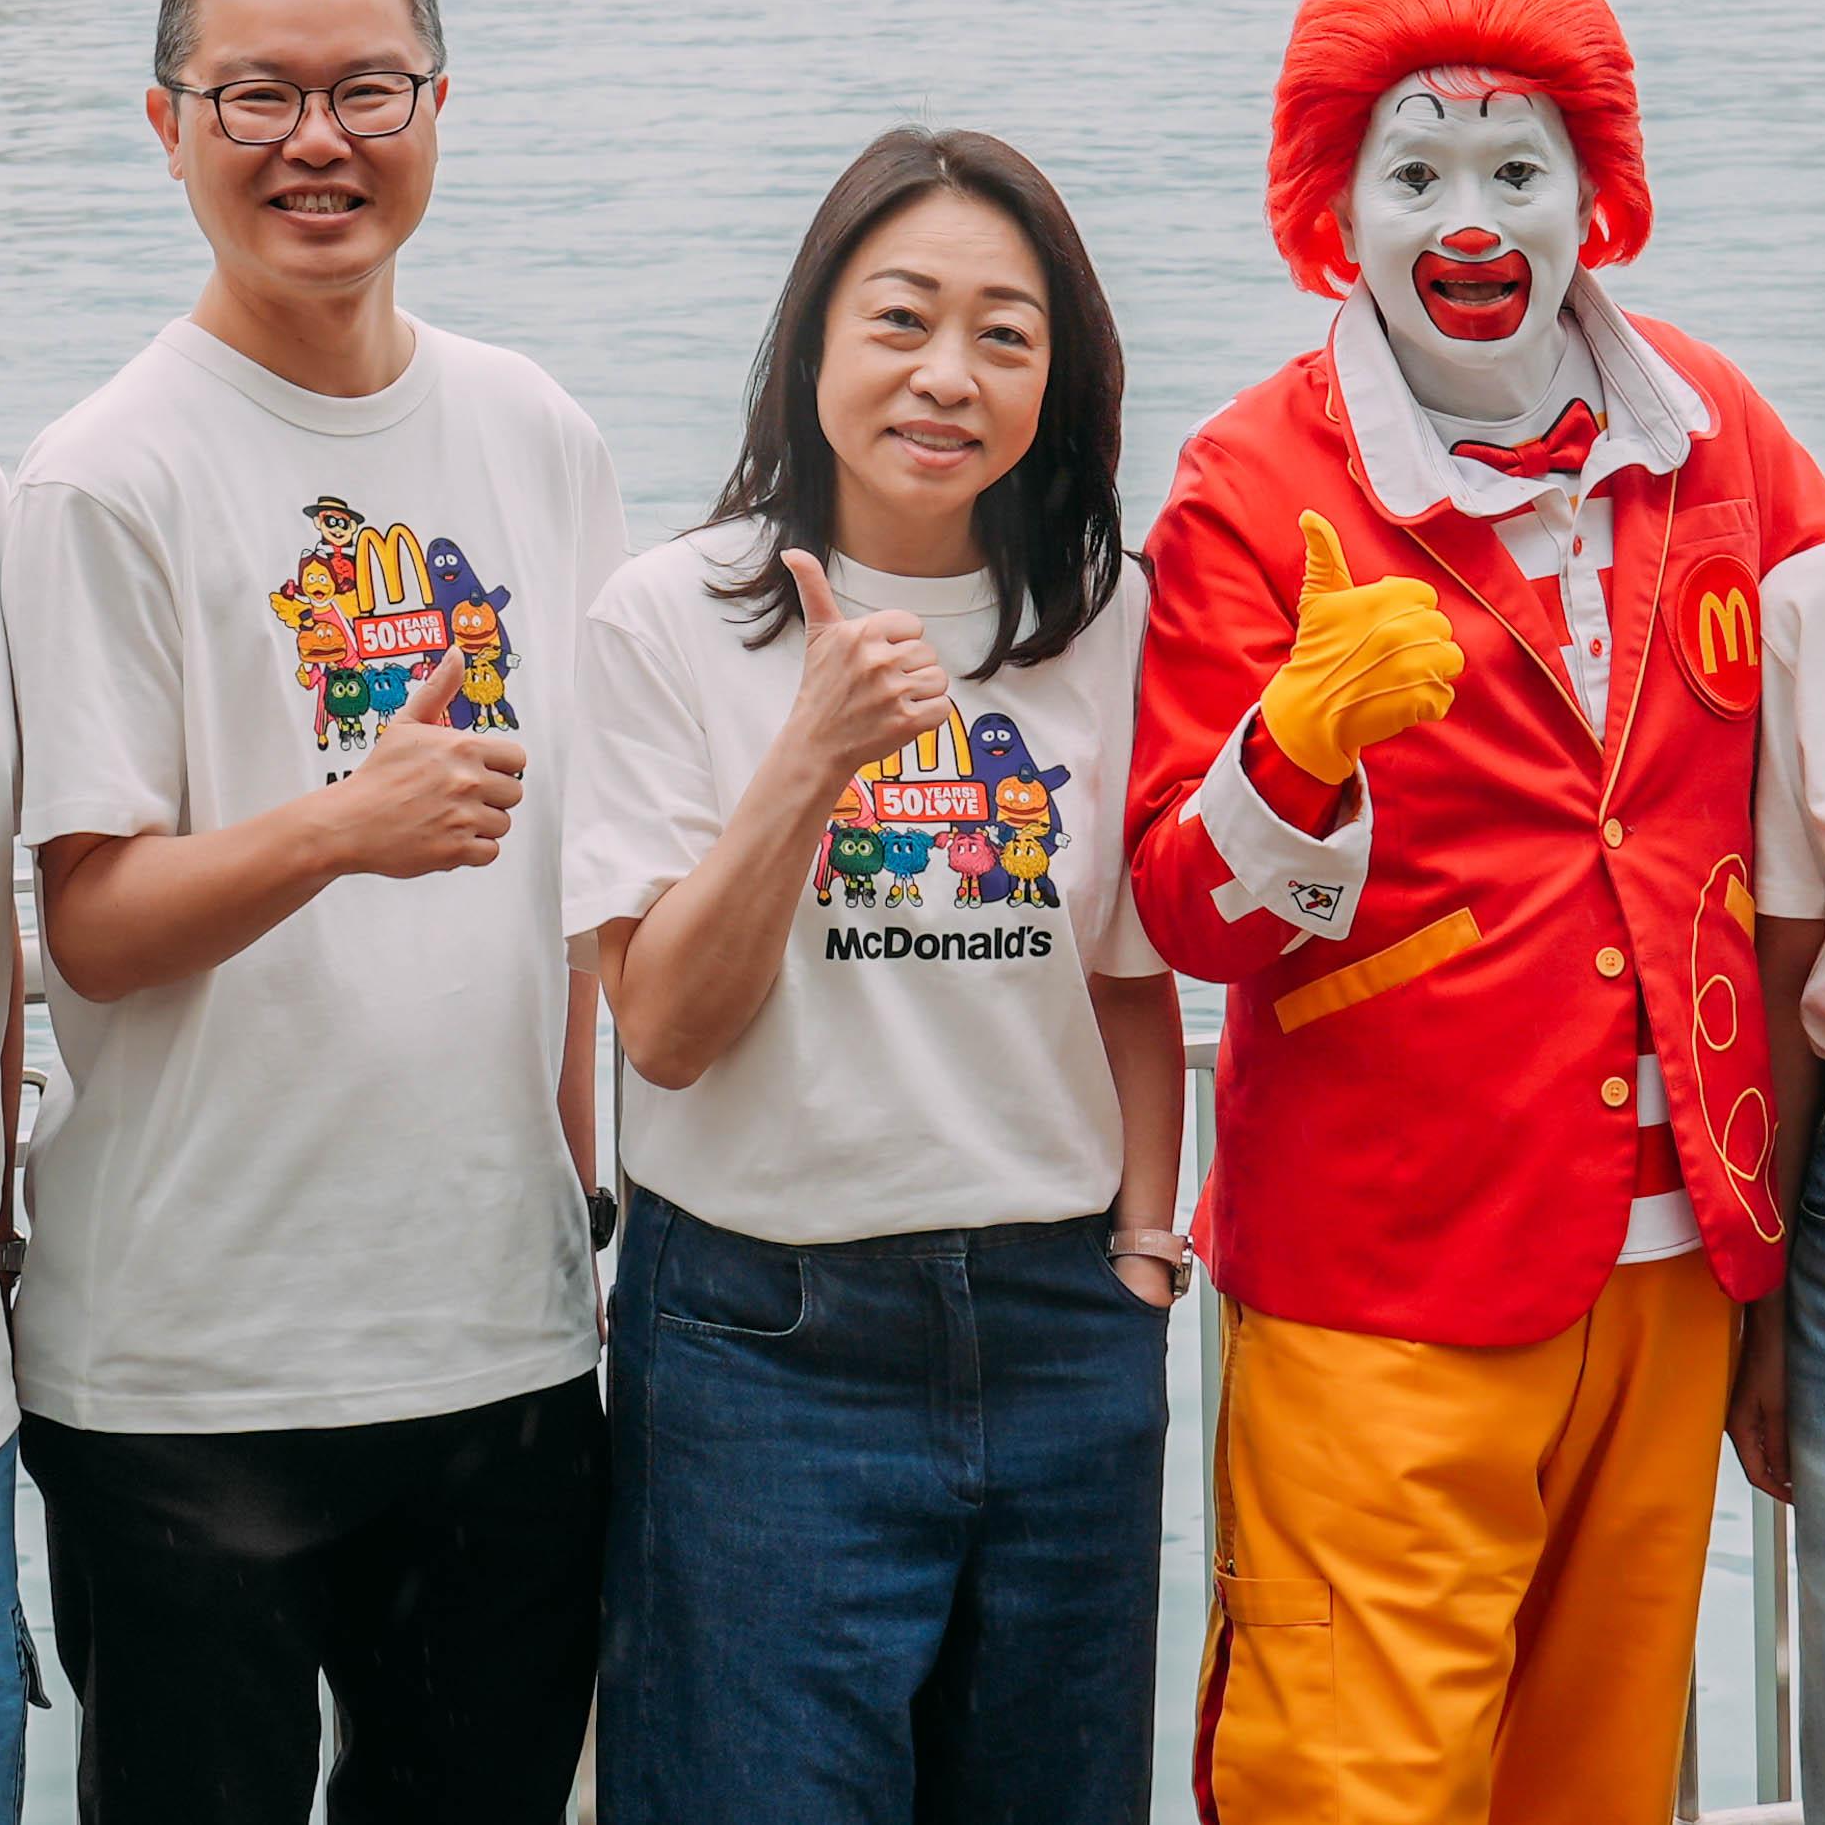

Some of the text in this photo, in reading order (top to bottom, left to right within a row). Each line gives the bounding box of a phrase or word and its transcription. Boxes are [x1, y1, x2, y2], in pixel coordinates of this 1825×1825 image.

[362, 621, 396, 652] 50
[883, 787, 923, 817] 50
[825, 926, 1052, 960] McDonald's
